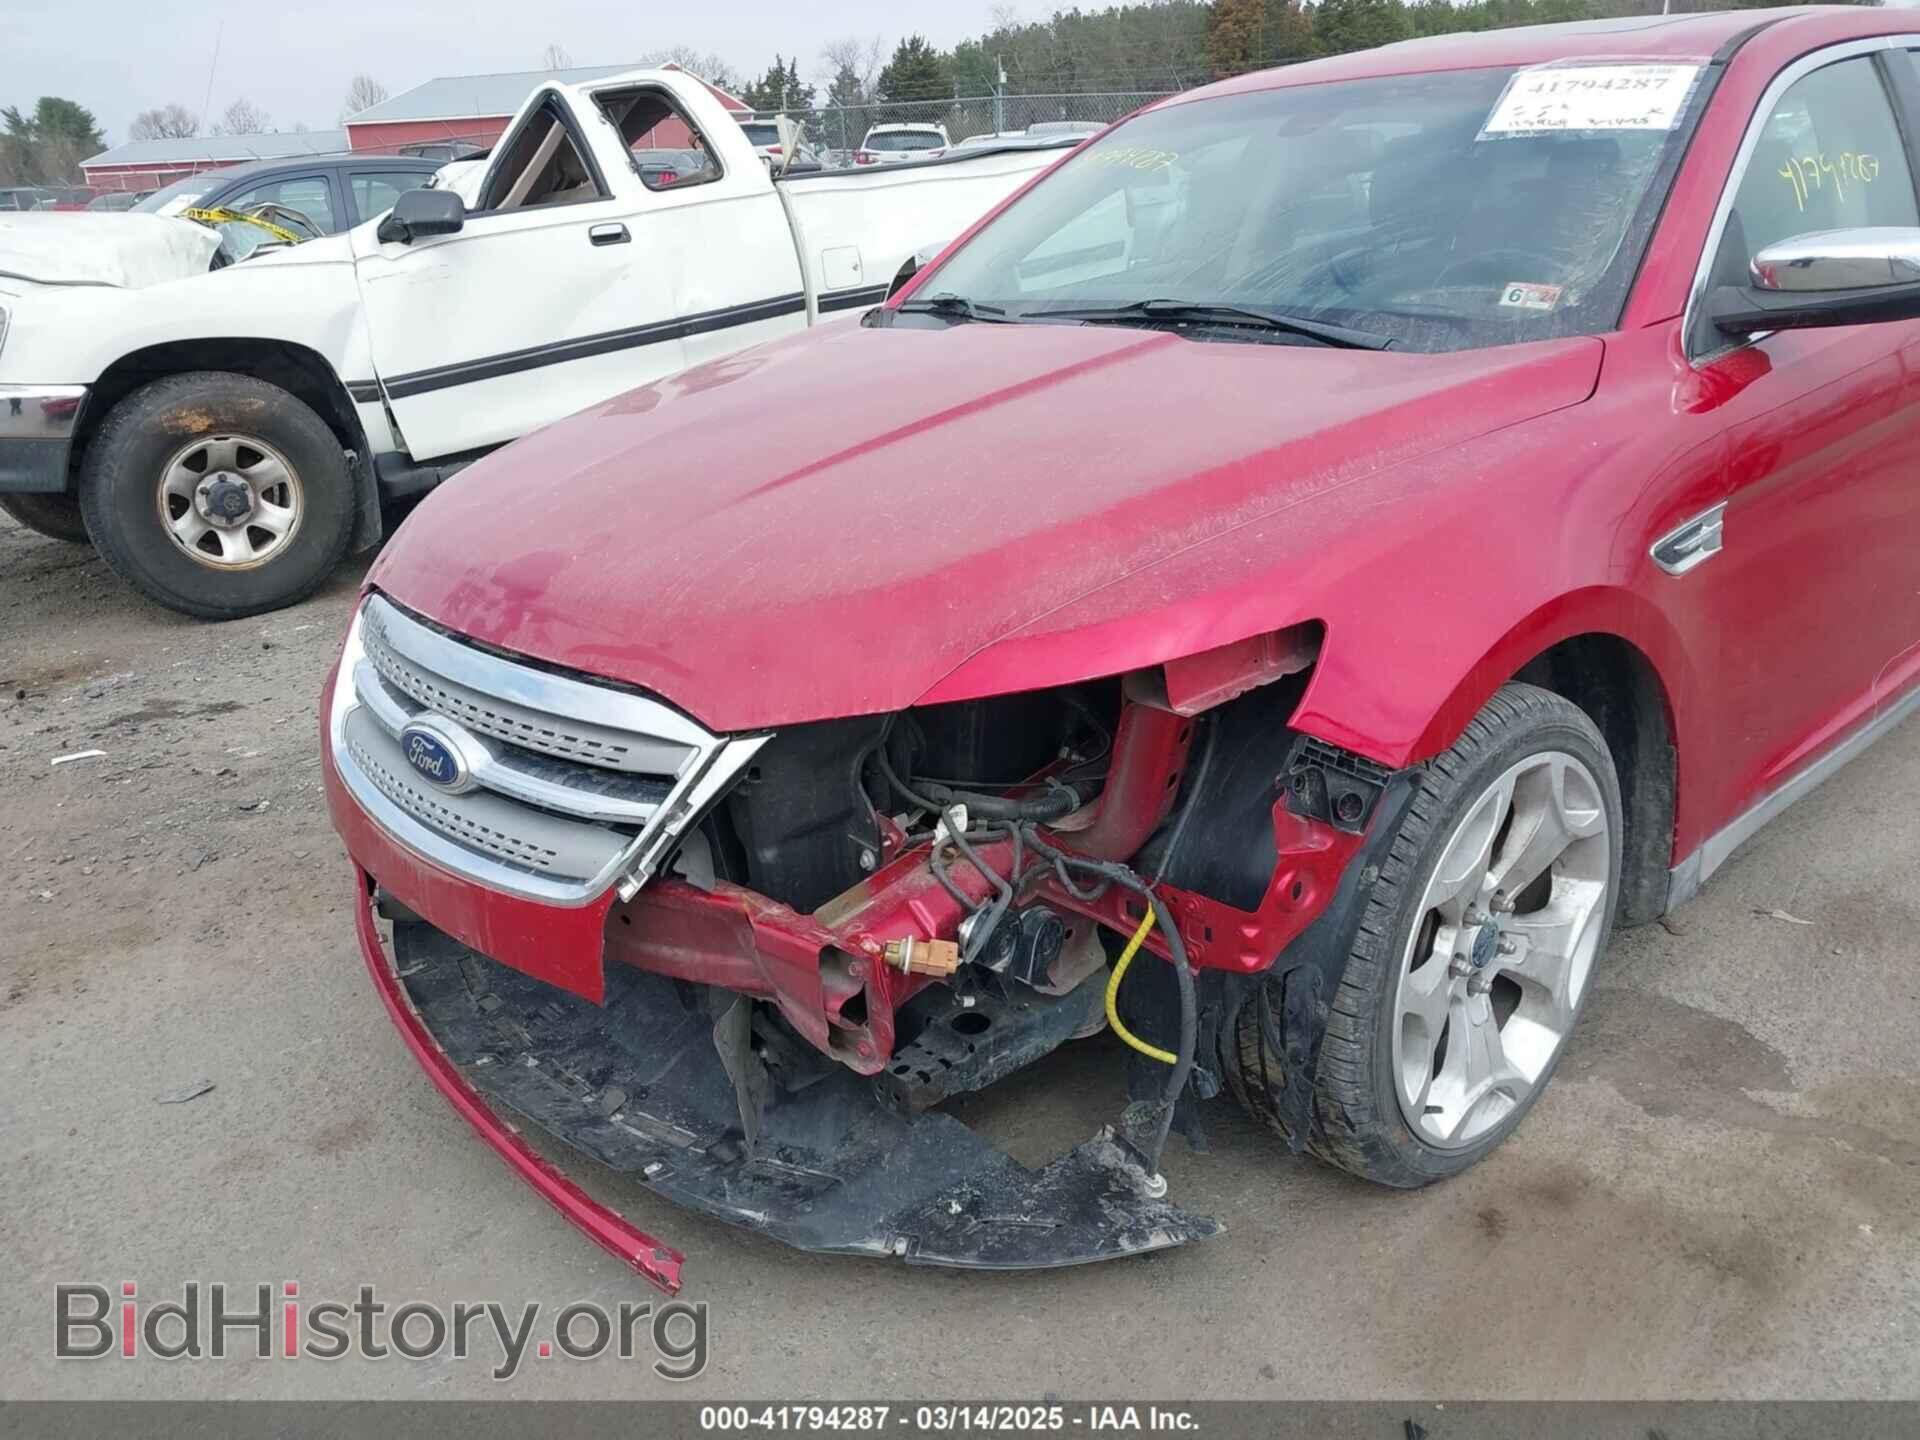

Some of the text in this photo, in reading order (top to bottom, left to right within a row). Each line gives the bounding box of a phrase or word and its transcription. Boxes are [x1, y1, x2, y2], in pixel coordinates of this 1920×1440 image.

[1527, 77, 1670, 95] 41794287
[1508, 288, 1523, 302] 6
[408, 735, 445, 777] Ford
